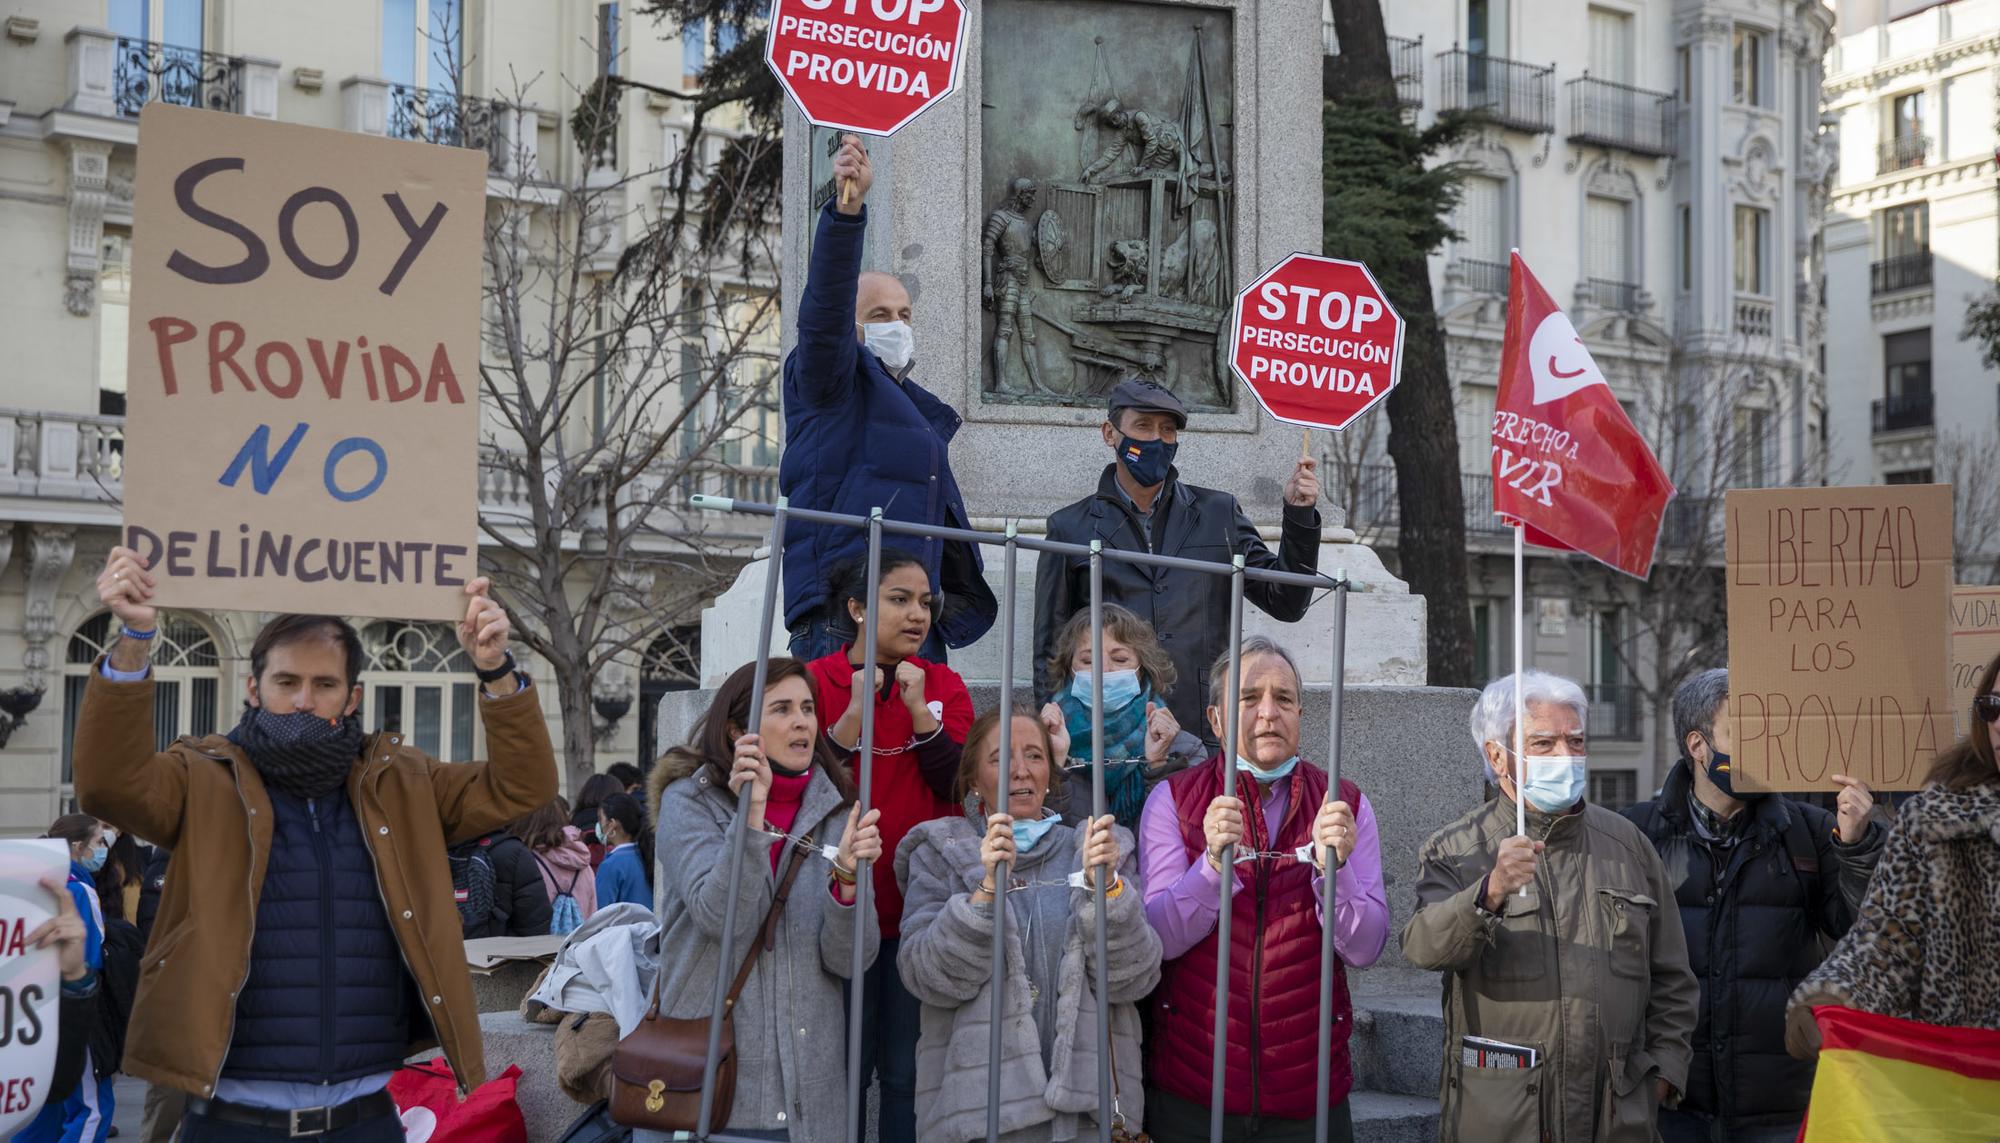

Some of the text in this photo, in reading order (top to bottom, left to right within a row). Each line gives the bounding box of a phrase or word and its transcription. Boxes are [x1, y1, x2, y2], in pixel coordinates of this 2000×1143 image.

[780, 15, 952, 62] PERSECUCIÓN
[786, 50, 931, 99] PROVIDA
[166, 157, 449, 296] SOY
[1257, 281, 1383, 334] STOP
[1242, 325, 1390, 364] PERSECUCIÓN
[1250, 355, 1376, 397] PROVIDA
[218, 422, 389, 502] NO
[1564, 441, 1579, 460] A
[1735, 506, 1921, 589] LIBERTAD
[1769, 597, 1862, 632] PARA
[1791, 641, 1855, 672] LOS
[1738, 693, 1938, 785] PROVIDA
